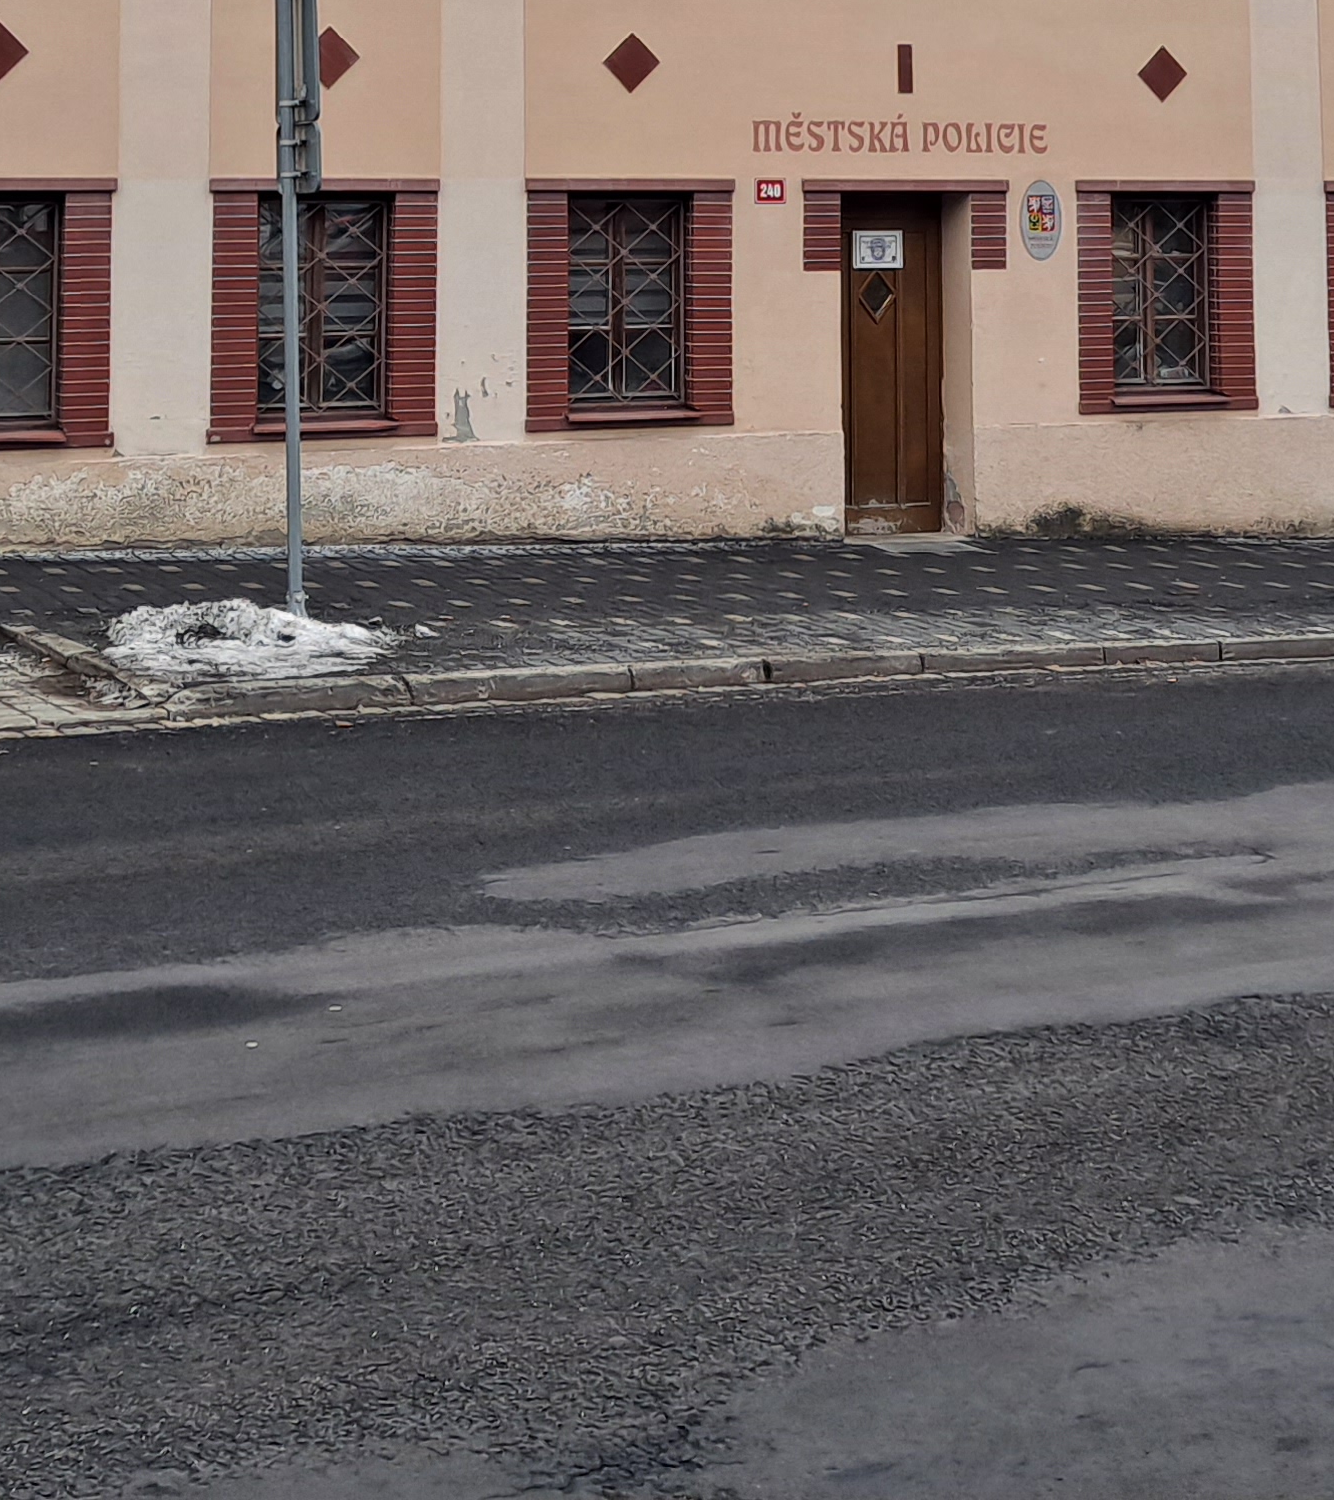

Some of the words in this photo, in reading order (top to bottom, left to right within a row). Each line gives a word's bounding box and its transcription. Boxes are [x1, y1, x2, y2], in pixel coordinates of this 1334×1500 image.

[751, 111, 910, 153] MĚSTSKÁ
[921, 121, 1049, 154] POLICIE
[759, 183, 782, 198] 240
